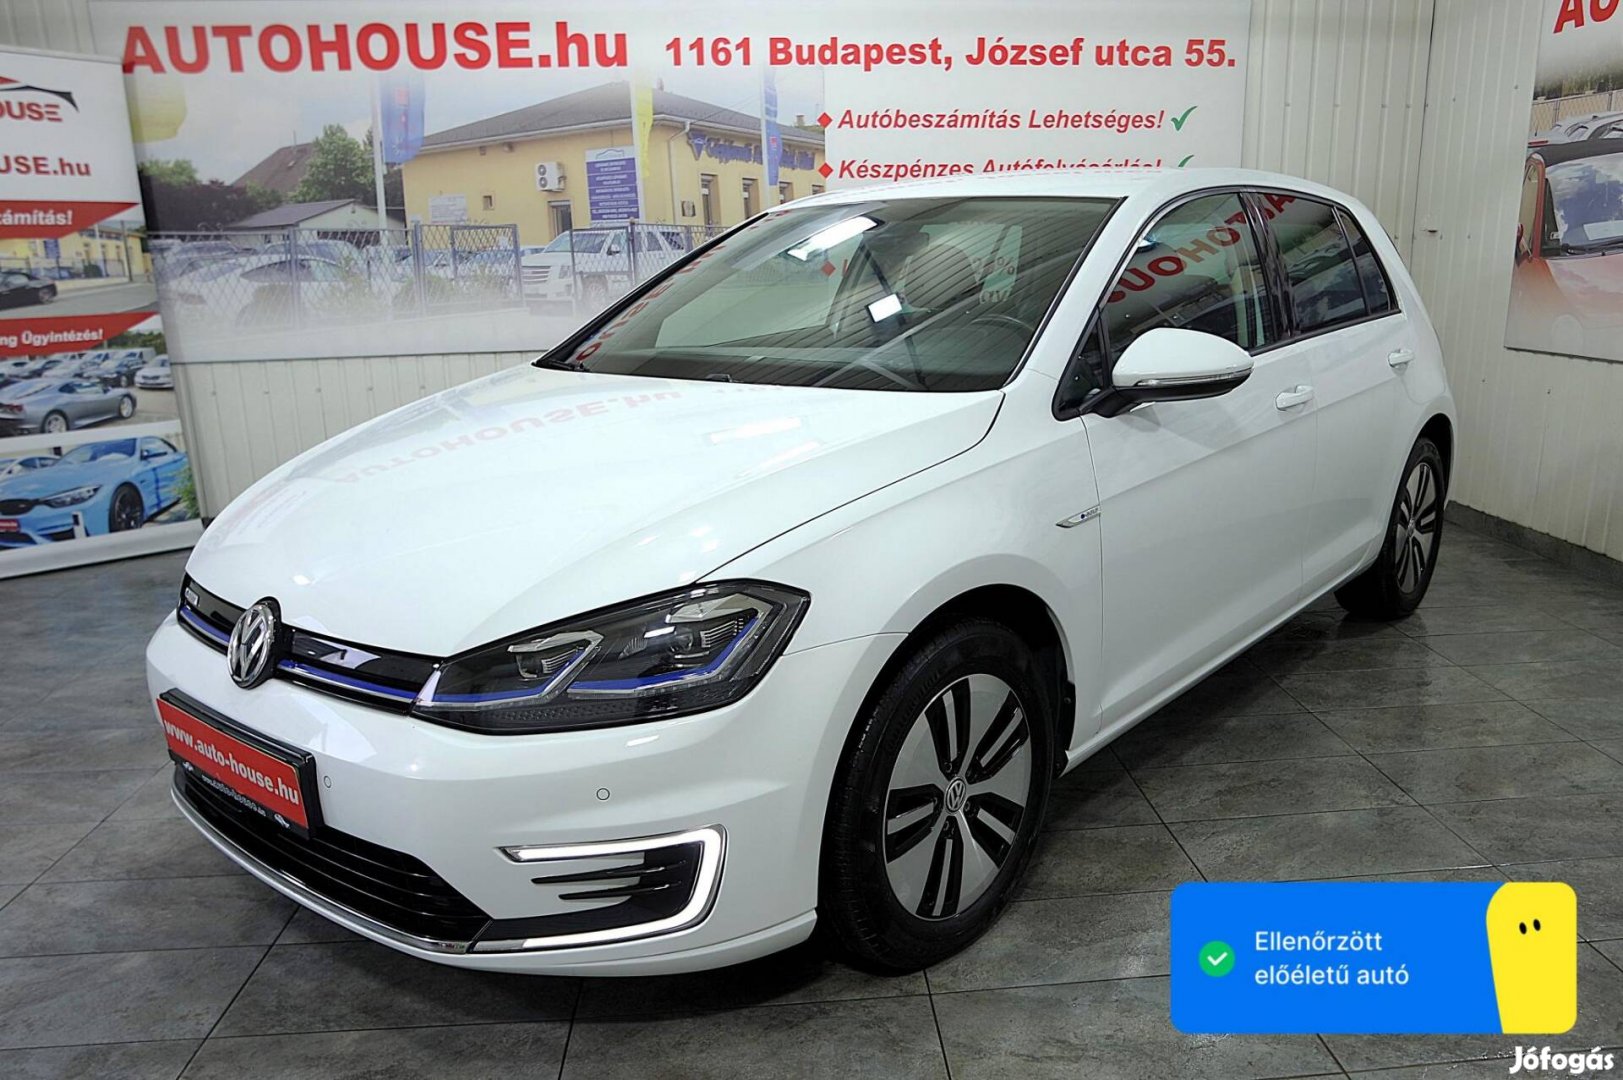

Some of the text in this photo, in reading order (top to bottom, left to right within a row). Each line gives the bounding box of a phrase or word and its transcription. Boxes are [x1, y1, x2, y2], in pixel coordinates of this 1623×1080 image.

[122, 21, 628, 74] AUTOHOUSE.hu
[665, 37, 1236, 71] 1161 Budapest, József utca 55.
[0, 100, 62, 122] USE
[837, 109, 1165, 134] Autóbeszámítás Lehetséges!
[839, 158, 974, 182] Készpénzes
[0, 209, 73, 226] ámítás!
[22, 329, 103, 346] Ügyintézés!
[164, 719, 299, 805] www.auto-house.hu
